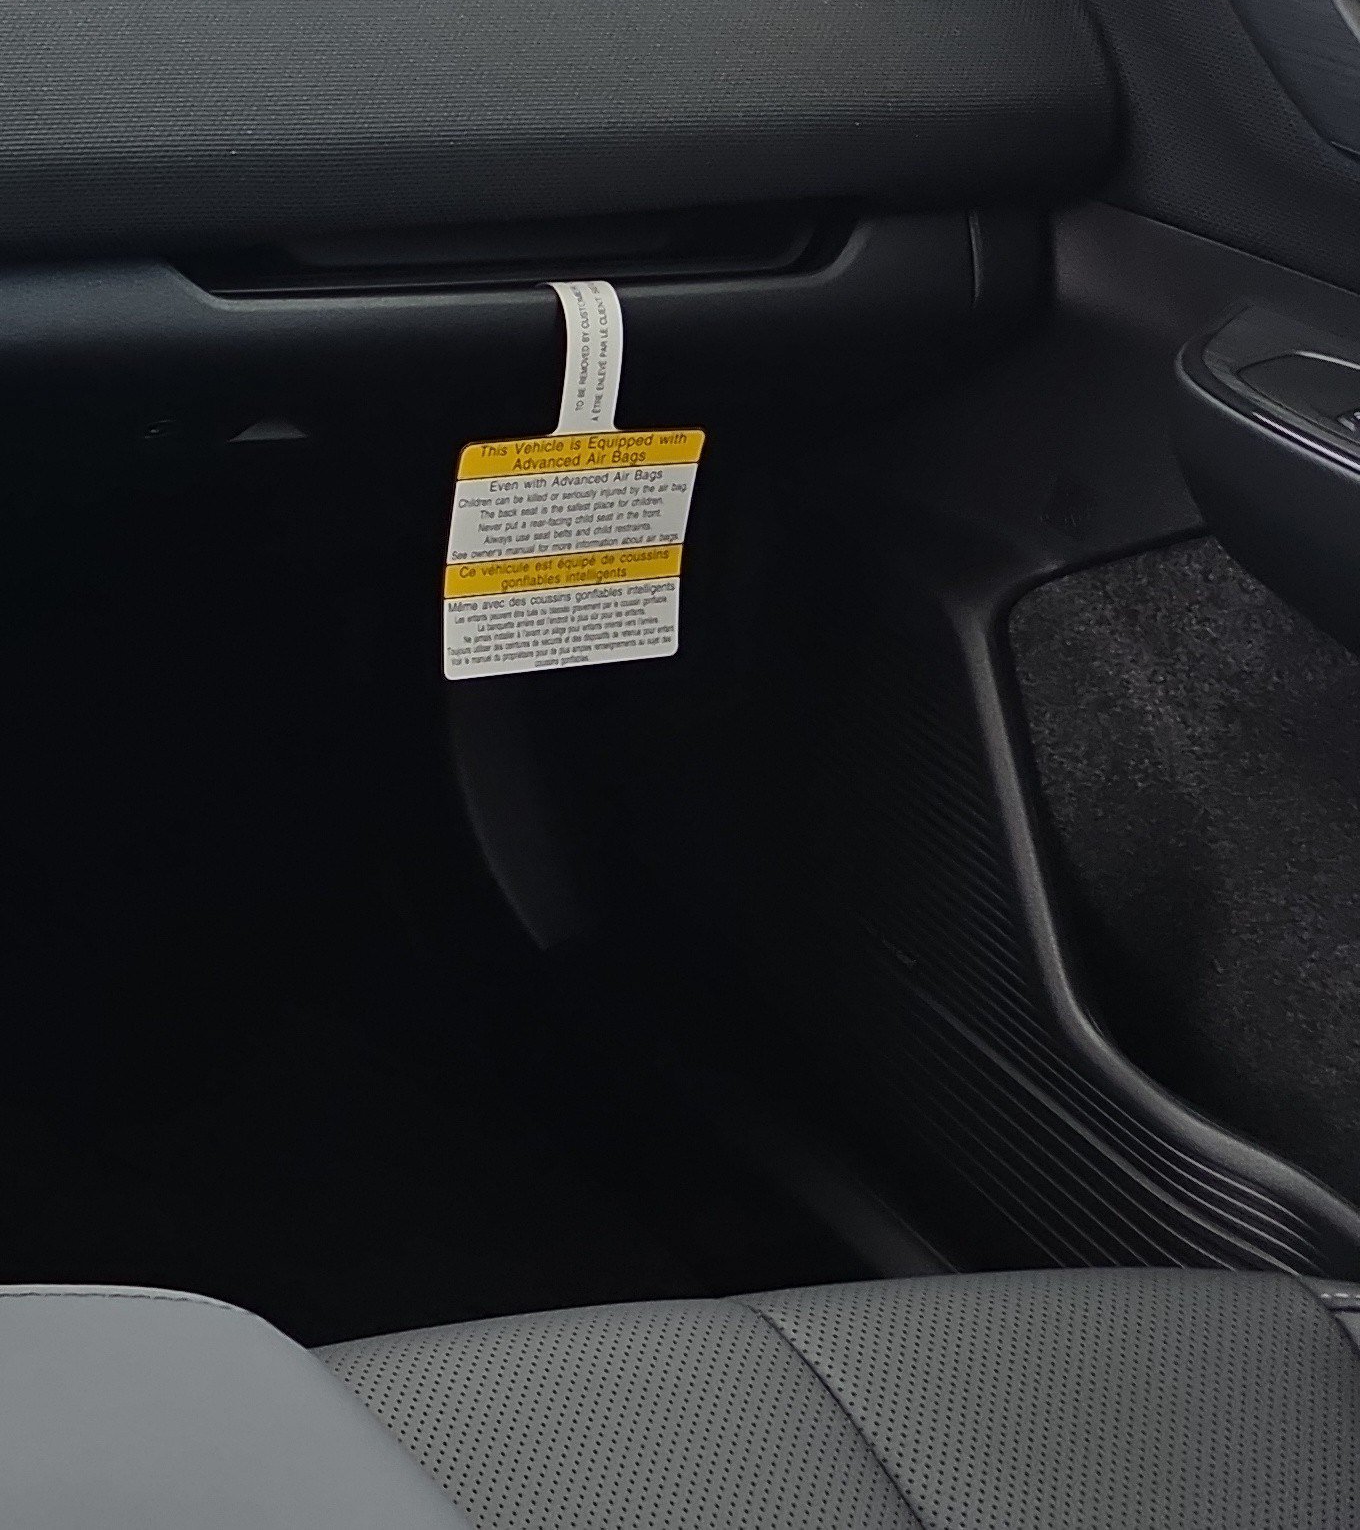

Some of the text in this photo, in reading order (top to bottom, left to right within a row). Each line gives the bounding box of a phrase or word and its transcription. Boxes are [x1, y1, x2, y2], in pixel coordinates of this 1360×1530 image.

[480, 432, 688, 458] This Vehicle is Equipped with
[512, 448, 646, 471] Advanced Air Bags
[489, 468, 663, 492] Even with Advanced Air Bags
[458, 497, 492, 508] Children
[495, 497, 510, 505] can
[513, 495, 524, 504] be
[550, 493, 559, 501] or
[630, 486, 639, 496] by
[643, 484, 655, 493] the
[480, 509, 495, 519] The
[459, 565, 476, 578] Ce
[534, 559, 552, 572] est
[601, 553, 615, 566] de
[619, 549, 670, 564] coussins
[481, 599, 505, 610] avec
[509, 597, 527, 607] des
